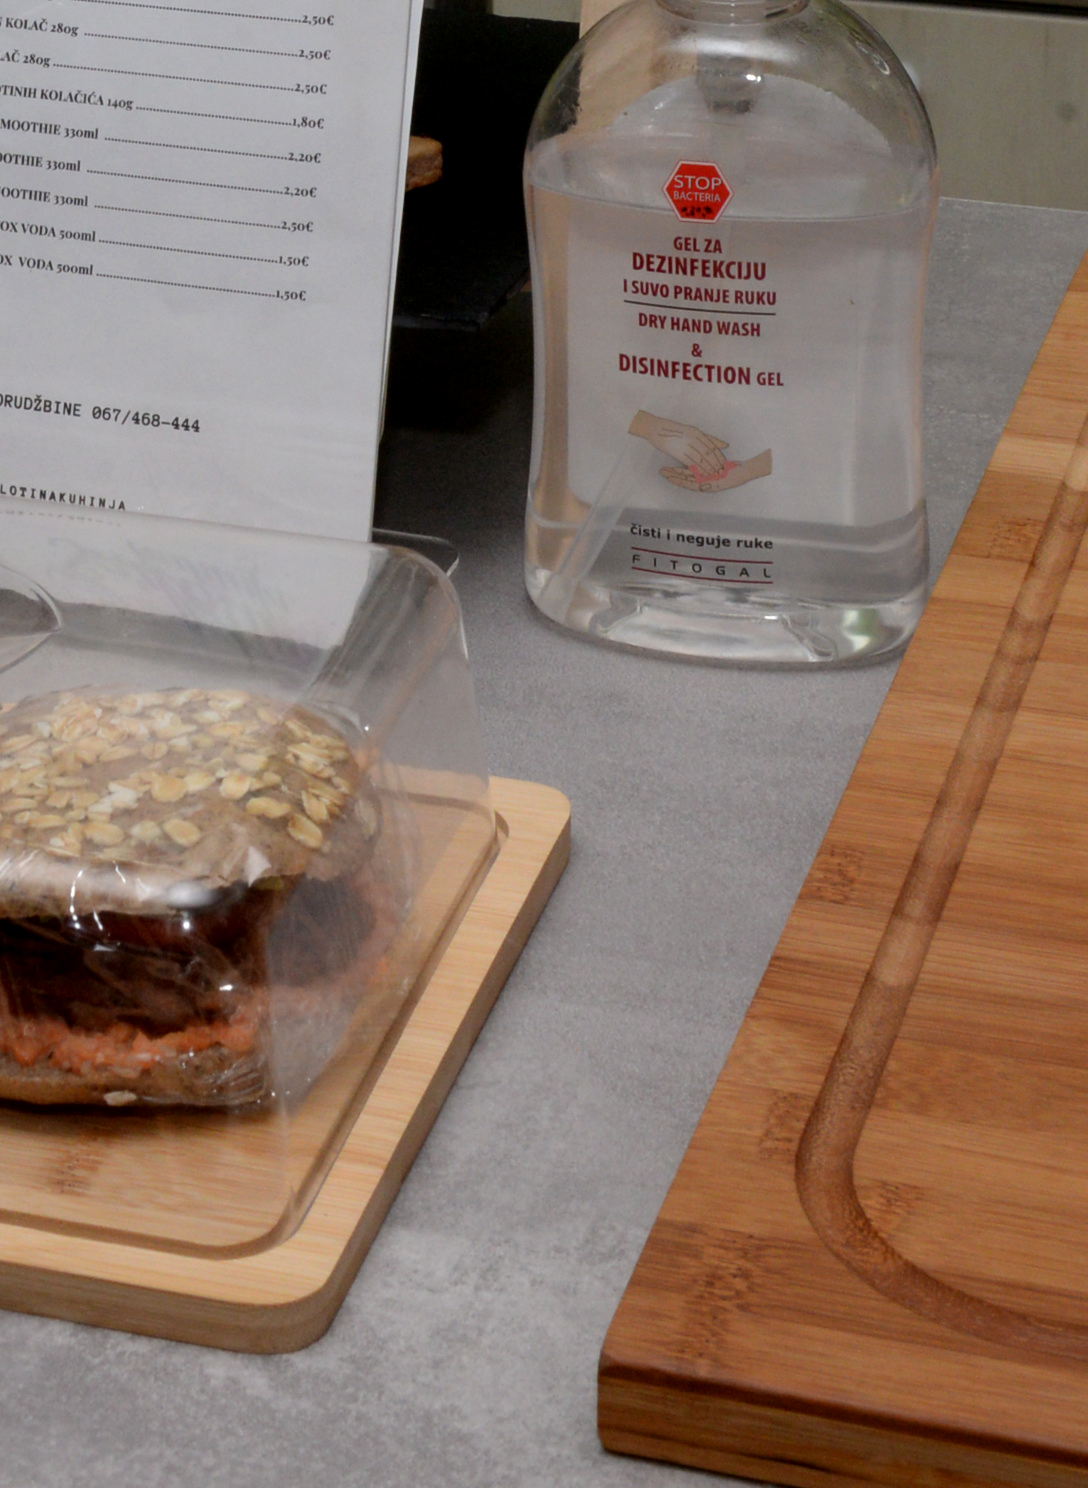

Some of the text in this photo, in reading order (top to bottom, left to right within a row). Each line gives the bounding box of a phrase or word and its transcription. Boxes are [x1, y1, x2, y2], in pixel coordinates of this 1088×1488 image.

[5, 17, 48, 32] KOLAČ
[50, 22, 79, 38] 280g
[22, 53, 51, 69] 280g
[107, 98, 134, 111] 140g
[64, 127, 99, 140] 330ml
[46, 159, 81, 172] 330ml
[673, 174, 723, 191] STOP
[54, 194, 89, 207] 330ml
[673, 191, 721, 203] BACTERIA
[20, 222, 57, 238] VODA
[59, 229, 96, 243] 500ml
[673, 237, 723, 254] GEL ZA
[18, 256, 54, 272] VODA
[56, 263, 94, 276] 500ml
[631, 251, 767, 281] DEZINFEKCIJU
[631, 280, 670, 299] SUVO
[674, 286, 730, 304] PRANJE
[734, 290, 777, 306] RUKU
[638, 312, 761, 337] DRY HAND WASH
[691, 343, 703, 358] &
[618, 354, 784, 387] DISINFECTION GEL
[630, 523, 662, 540] čisti
[676, 532, 732, 550] neguje
[736, 537, 773, 550] ruke
